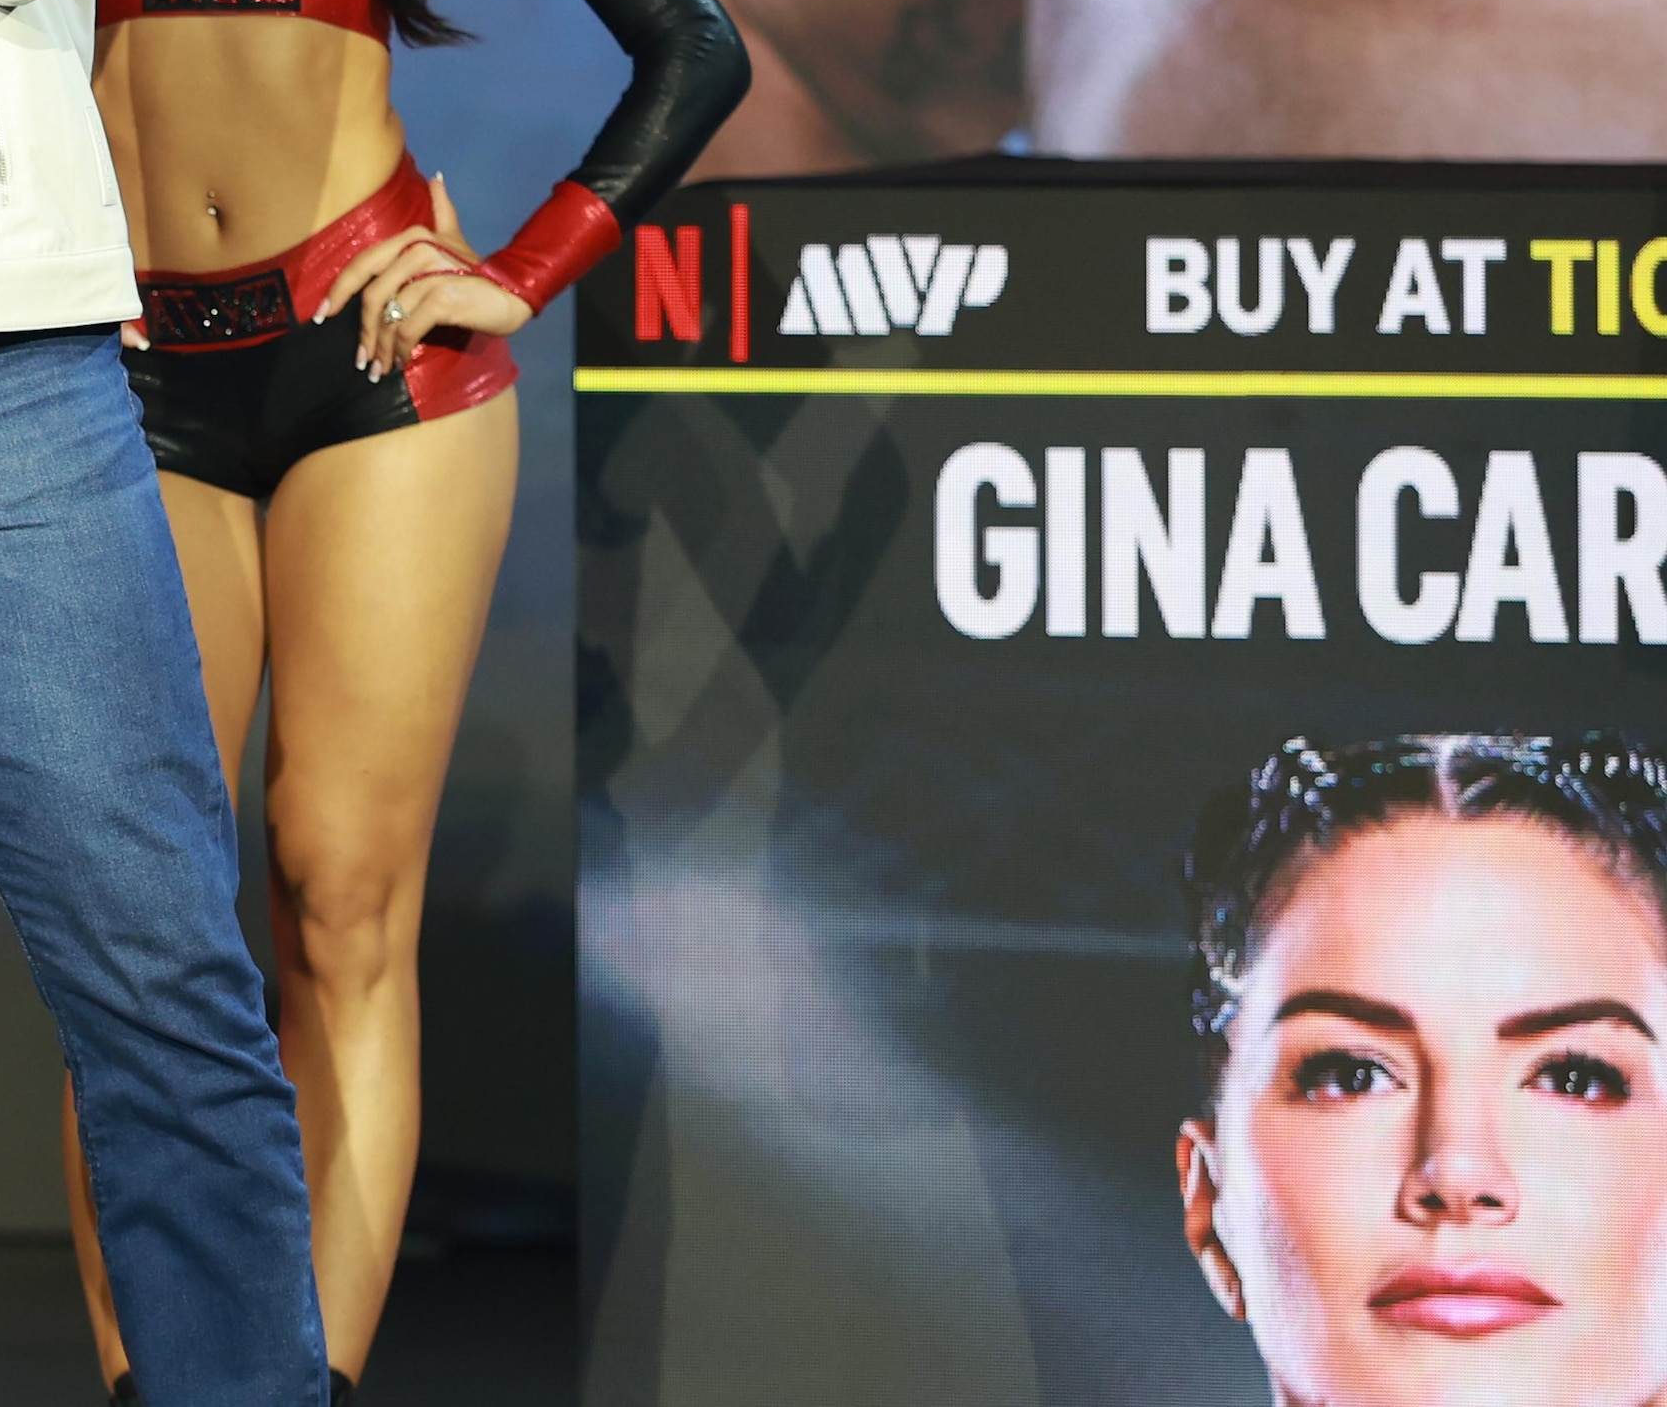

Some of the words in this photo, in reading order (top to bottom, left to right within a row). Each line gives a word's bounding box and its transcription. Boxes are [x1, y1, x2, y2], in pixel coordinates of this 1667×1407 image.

[634, 224, 703, 343] N
[1145, 237, 1356, 337] BUY
[1377, 238, 1508, 336] AT
[933, 441, 1328, 641] GINA
[1355, 444, 1667, 646] CAR
